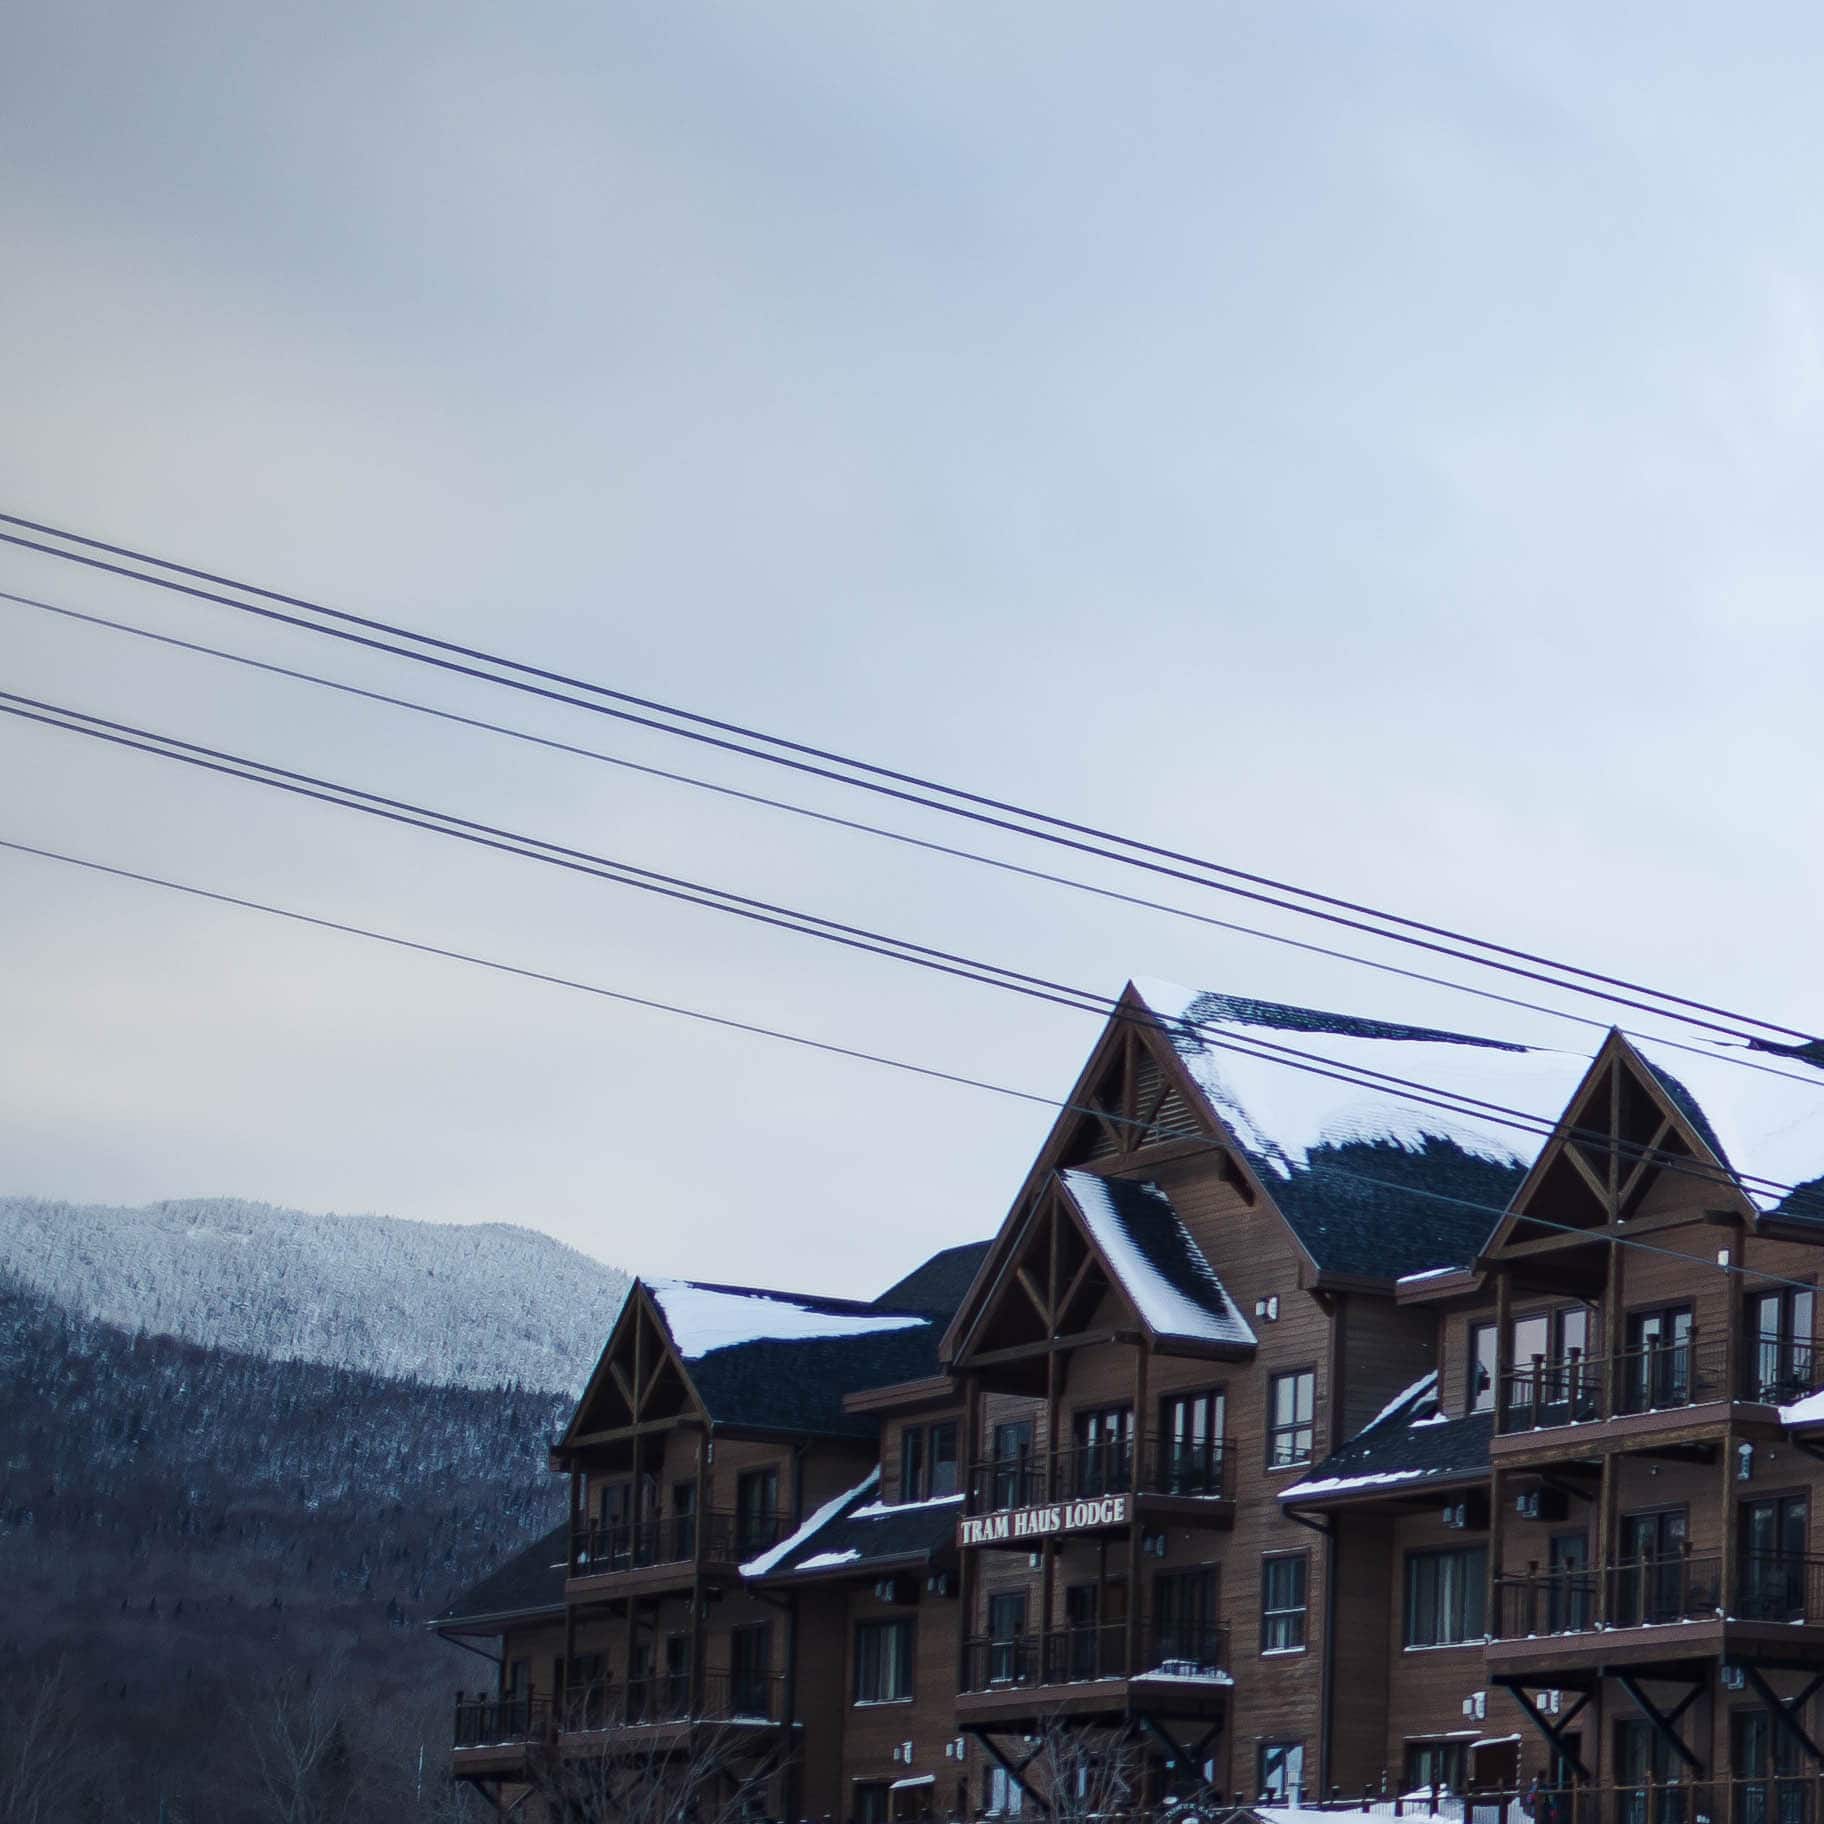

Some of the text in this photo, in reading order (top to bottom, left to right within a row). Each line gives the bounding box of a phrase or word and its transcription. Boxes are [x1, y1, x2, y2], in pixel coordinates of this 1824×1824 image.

[961, 1498, 1125, 1544] TRAM HAUS LODGE
